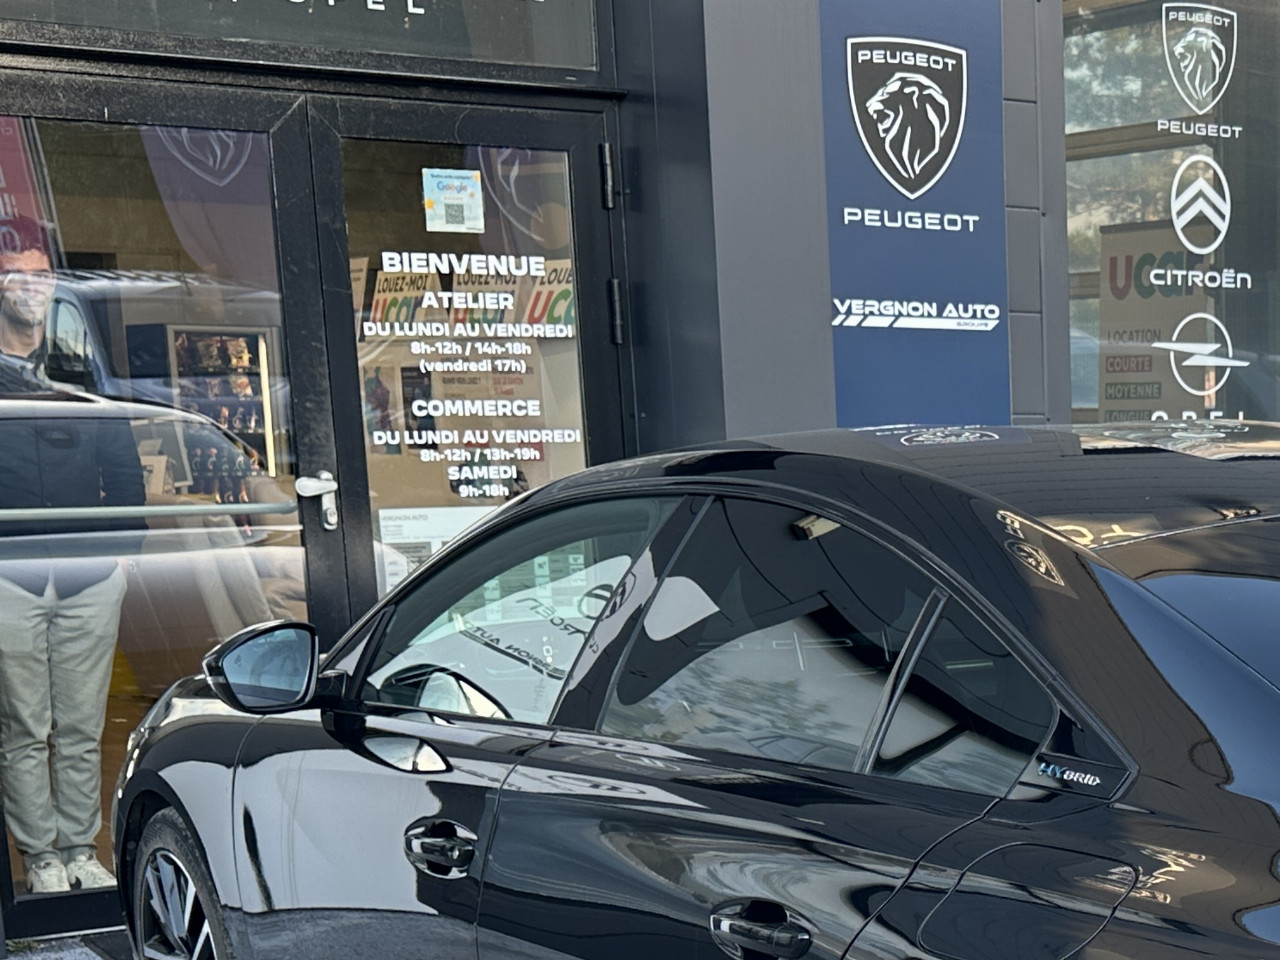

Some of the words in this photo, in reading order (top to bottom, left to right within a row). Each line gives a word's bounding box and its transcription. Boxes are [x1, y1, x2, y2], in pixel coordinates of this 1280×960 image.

[1169, 11, 1231, 27] PEUGEOT
[857, 49, 957, 72] PEUGEOT
[1157, 119, 1243, 138] PEUGEOT
[437, 181, 467, 194] Google
[843, 207, 980, 232] PEUGEOT
[381, 251, 546, 277] BIENVENUE
[377, 273, 430, 294] LOUEZ-MOI
[421, 291, 514, 310] ATELIER
[833, 298, 938, 318] VERGNON
[942, 302, 1000, 320] AUTO
[363, 322, 391, 336] DU
[394, 322, 449, 337] LUNDI
[453, 322, 480, 337] AU
[483, 323, 573, 338] VENDREDI
[1107, 329, 1161, 345] LOCATION
[410, 341, 462, 355] 8h-12h
[474, 341, 532, 355] 14h-18h
[419, 358, 492, 373] (vendredi
[494, 358, 527, 373] 17h)
[1106, 356, 1150, 372] COURTE
[1106, 384, 1160, 399] MOYENNE
[411, 399, 541, 417] COMMERCE
[372, 431, 400, 445] DU
[404, 430, 459, 445] LUNDI
[463, 430, 488, 444] AU
[492, 429, 581, 443] VENDREDI
[420, 448, 471, 462] 8h-12h
[483, 448, 540, 461] 13h-19h
[447, 465, 517, 481] SAMEDI
[458, 484, 509, 498] 9h-18h
[1037, 762, 1101, 786] HYBRID
